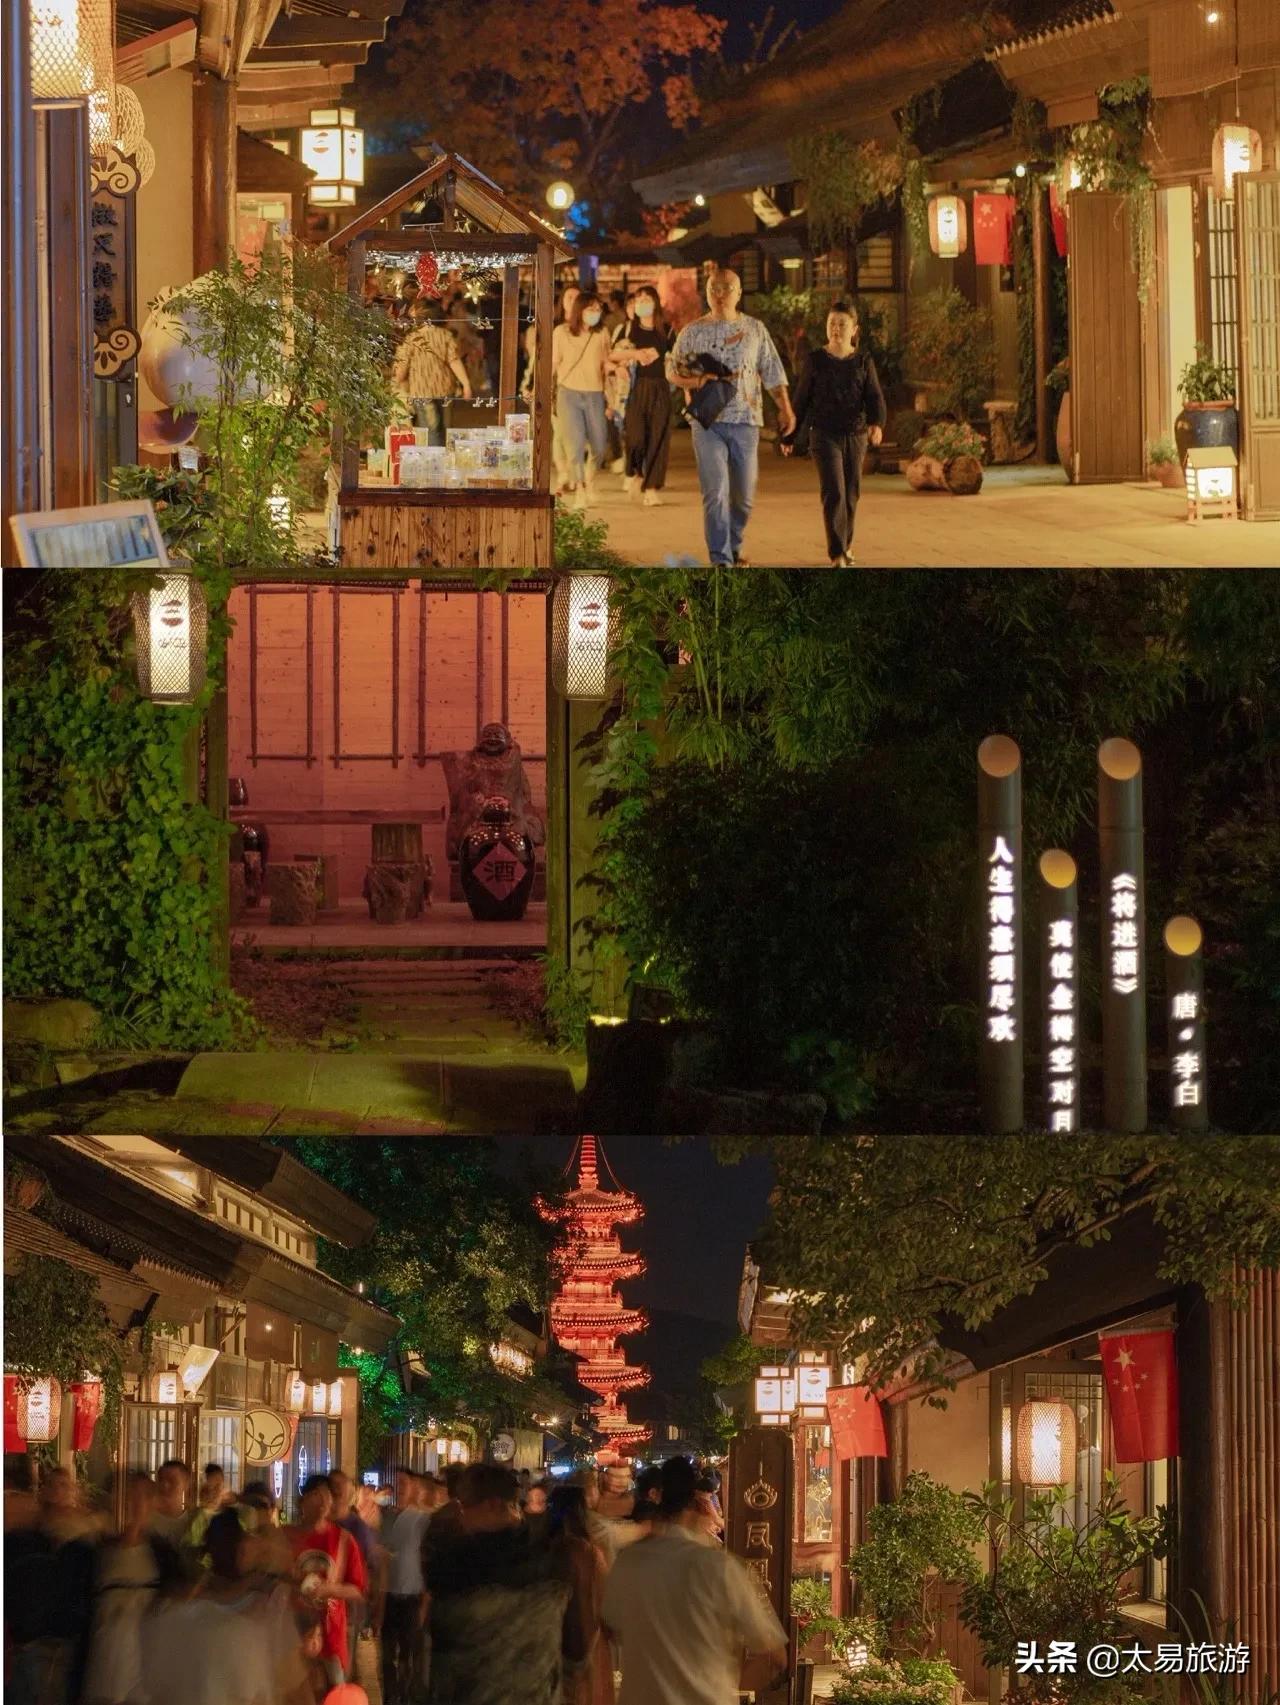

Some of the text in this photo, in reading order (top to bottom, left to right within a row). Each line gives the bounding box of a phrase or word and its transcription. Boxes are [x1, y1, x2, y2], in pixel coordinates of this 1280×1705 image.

[482, 860, 517, 883] 酒
[987, 836, 1016, 1042] 人生得意须尽欢
